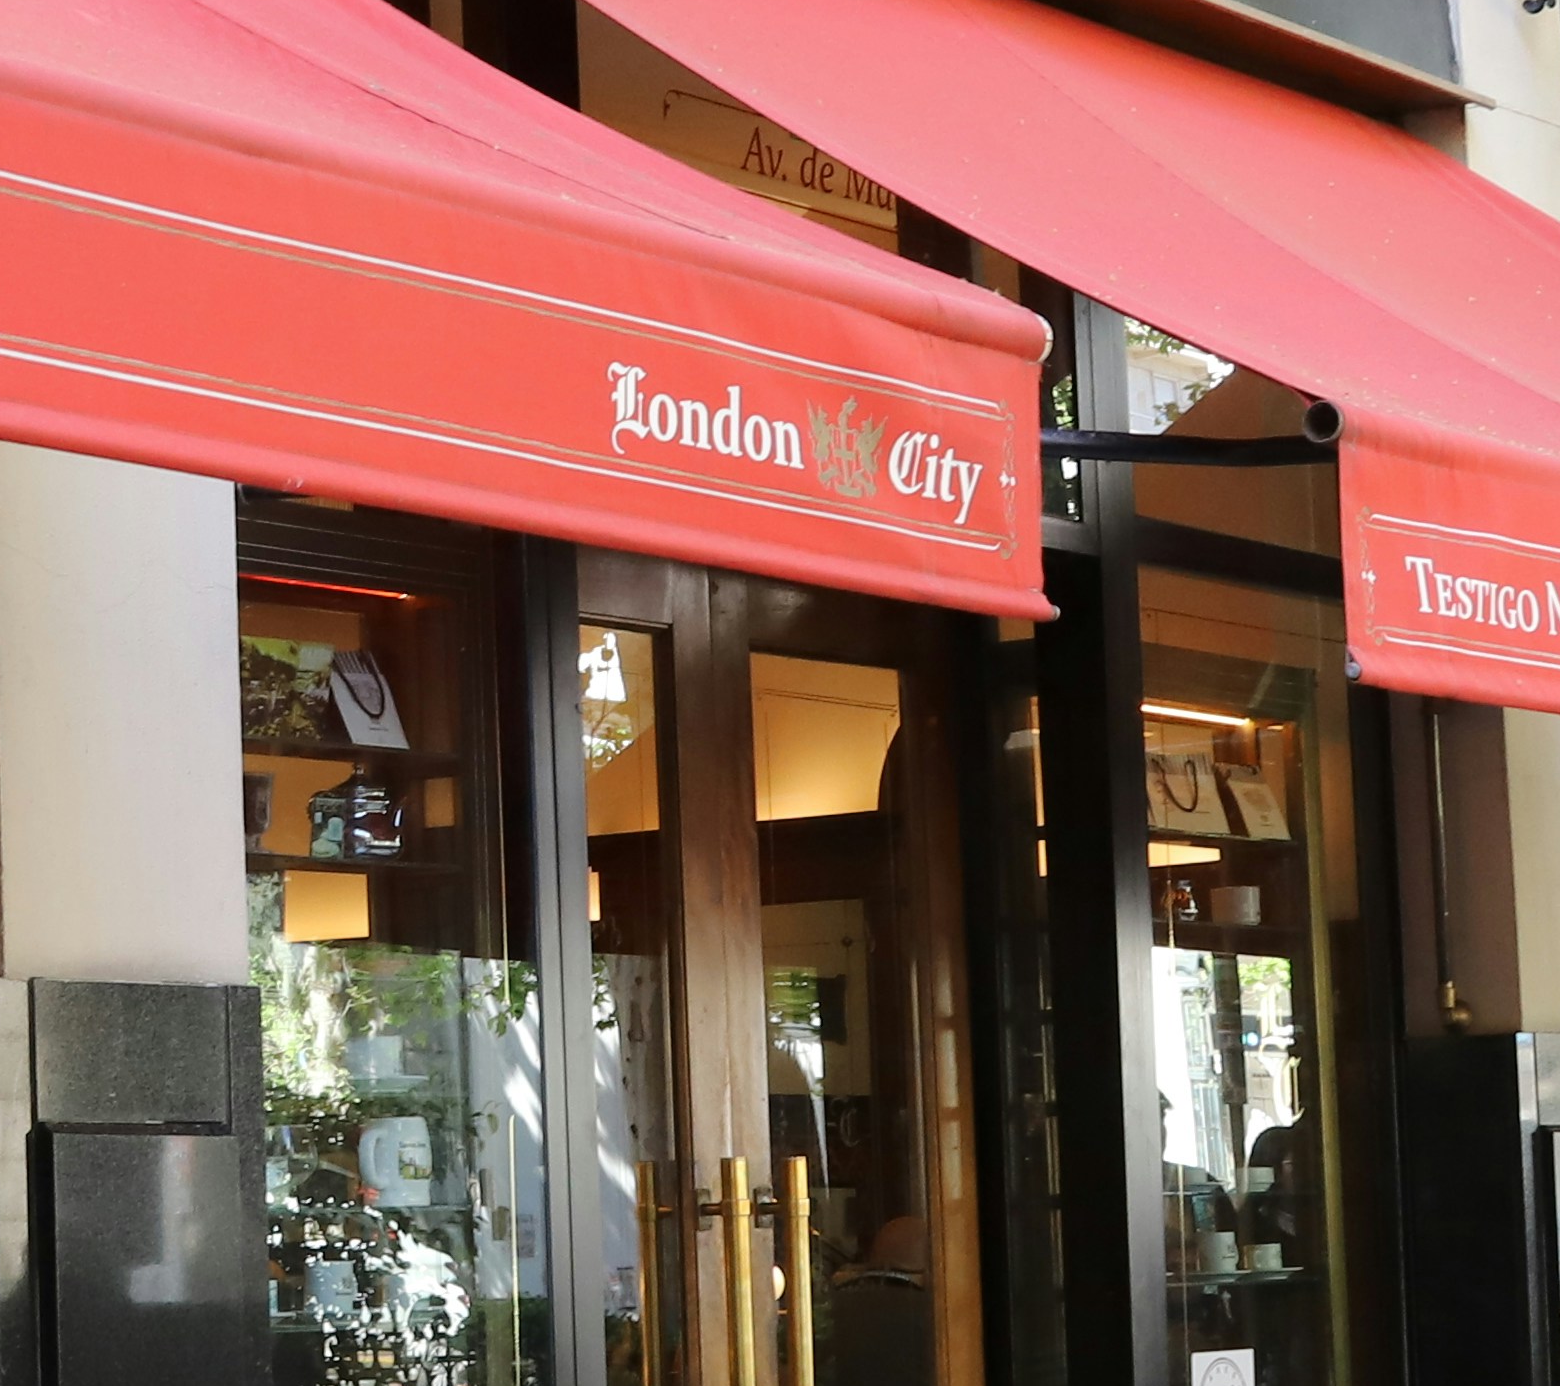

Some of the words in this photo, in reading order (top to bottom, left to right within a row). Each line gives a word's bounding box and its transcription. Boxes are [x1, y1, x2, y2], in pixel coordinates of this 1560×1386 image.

[740, 126, 788, 182] Av.
[799, 147, 835, 194] de
[606, 361, 805, 471] London
[887, 430, 984, 526] City
[1404, 555, 1541, 634] TESTIGO
